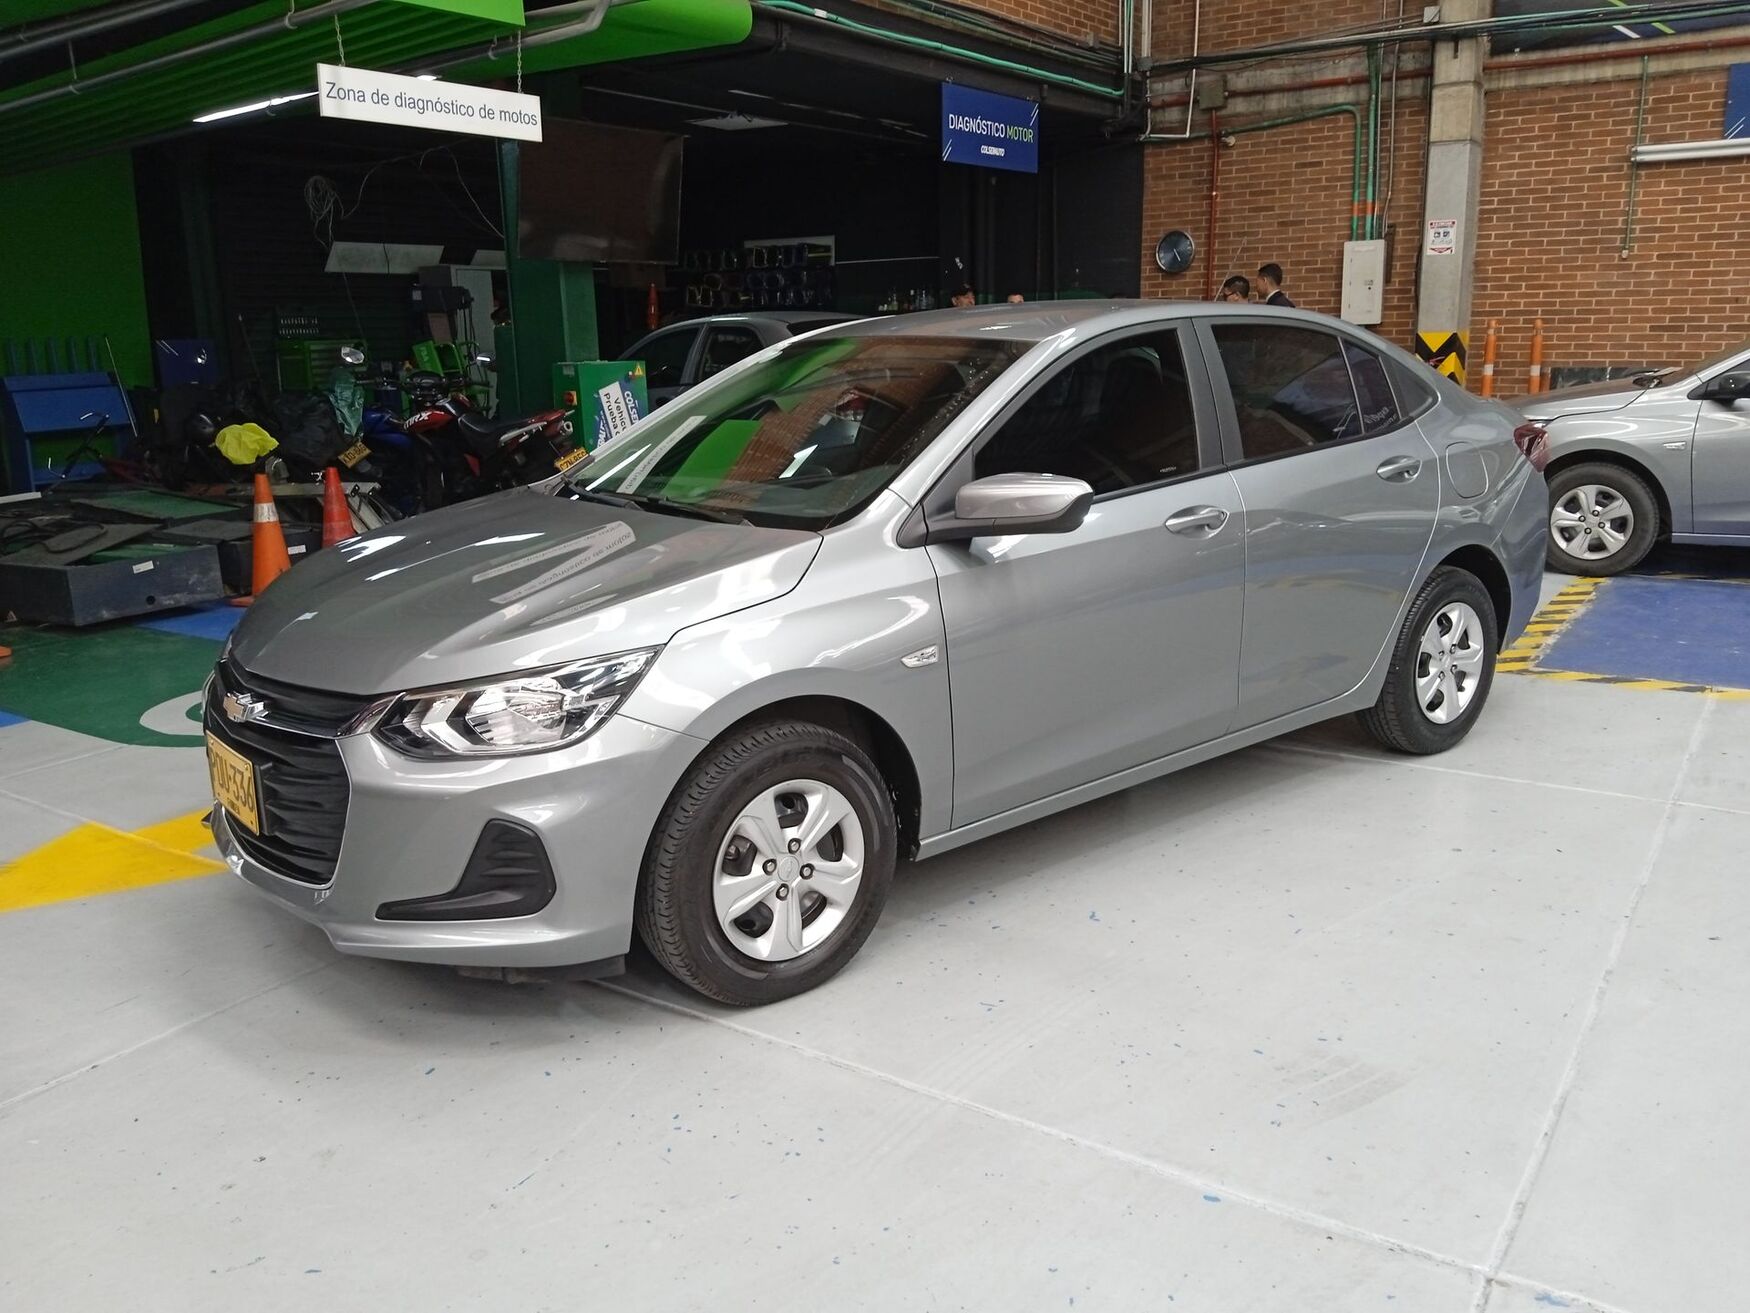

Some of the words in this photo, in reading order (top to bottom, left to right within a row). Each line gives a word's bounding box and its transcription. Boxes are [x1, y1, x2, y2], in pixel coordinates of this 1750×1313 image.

[326, 81, 366, 103] Zona
[371, 88, 390, 106] de
[395, 92, 475, 117] diagnóstico
[479, 104, 495, 120] de
[500, 108, 538, 126] motos
[948, 113, 1006, 138] DIAGNÓSTICO
[1006, 124, 1034, 143] MOTOR
[604, 392, 618, 430] Prueba
[624, 391, 639, 422] COLSE
